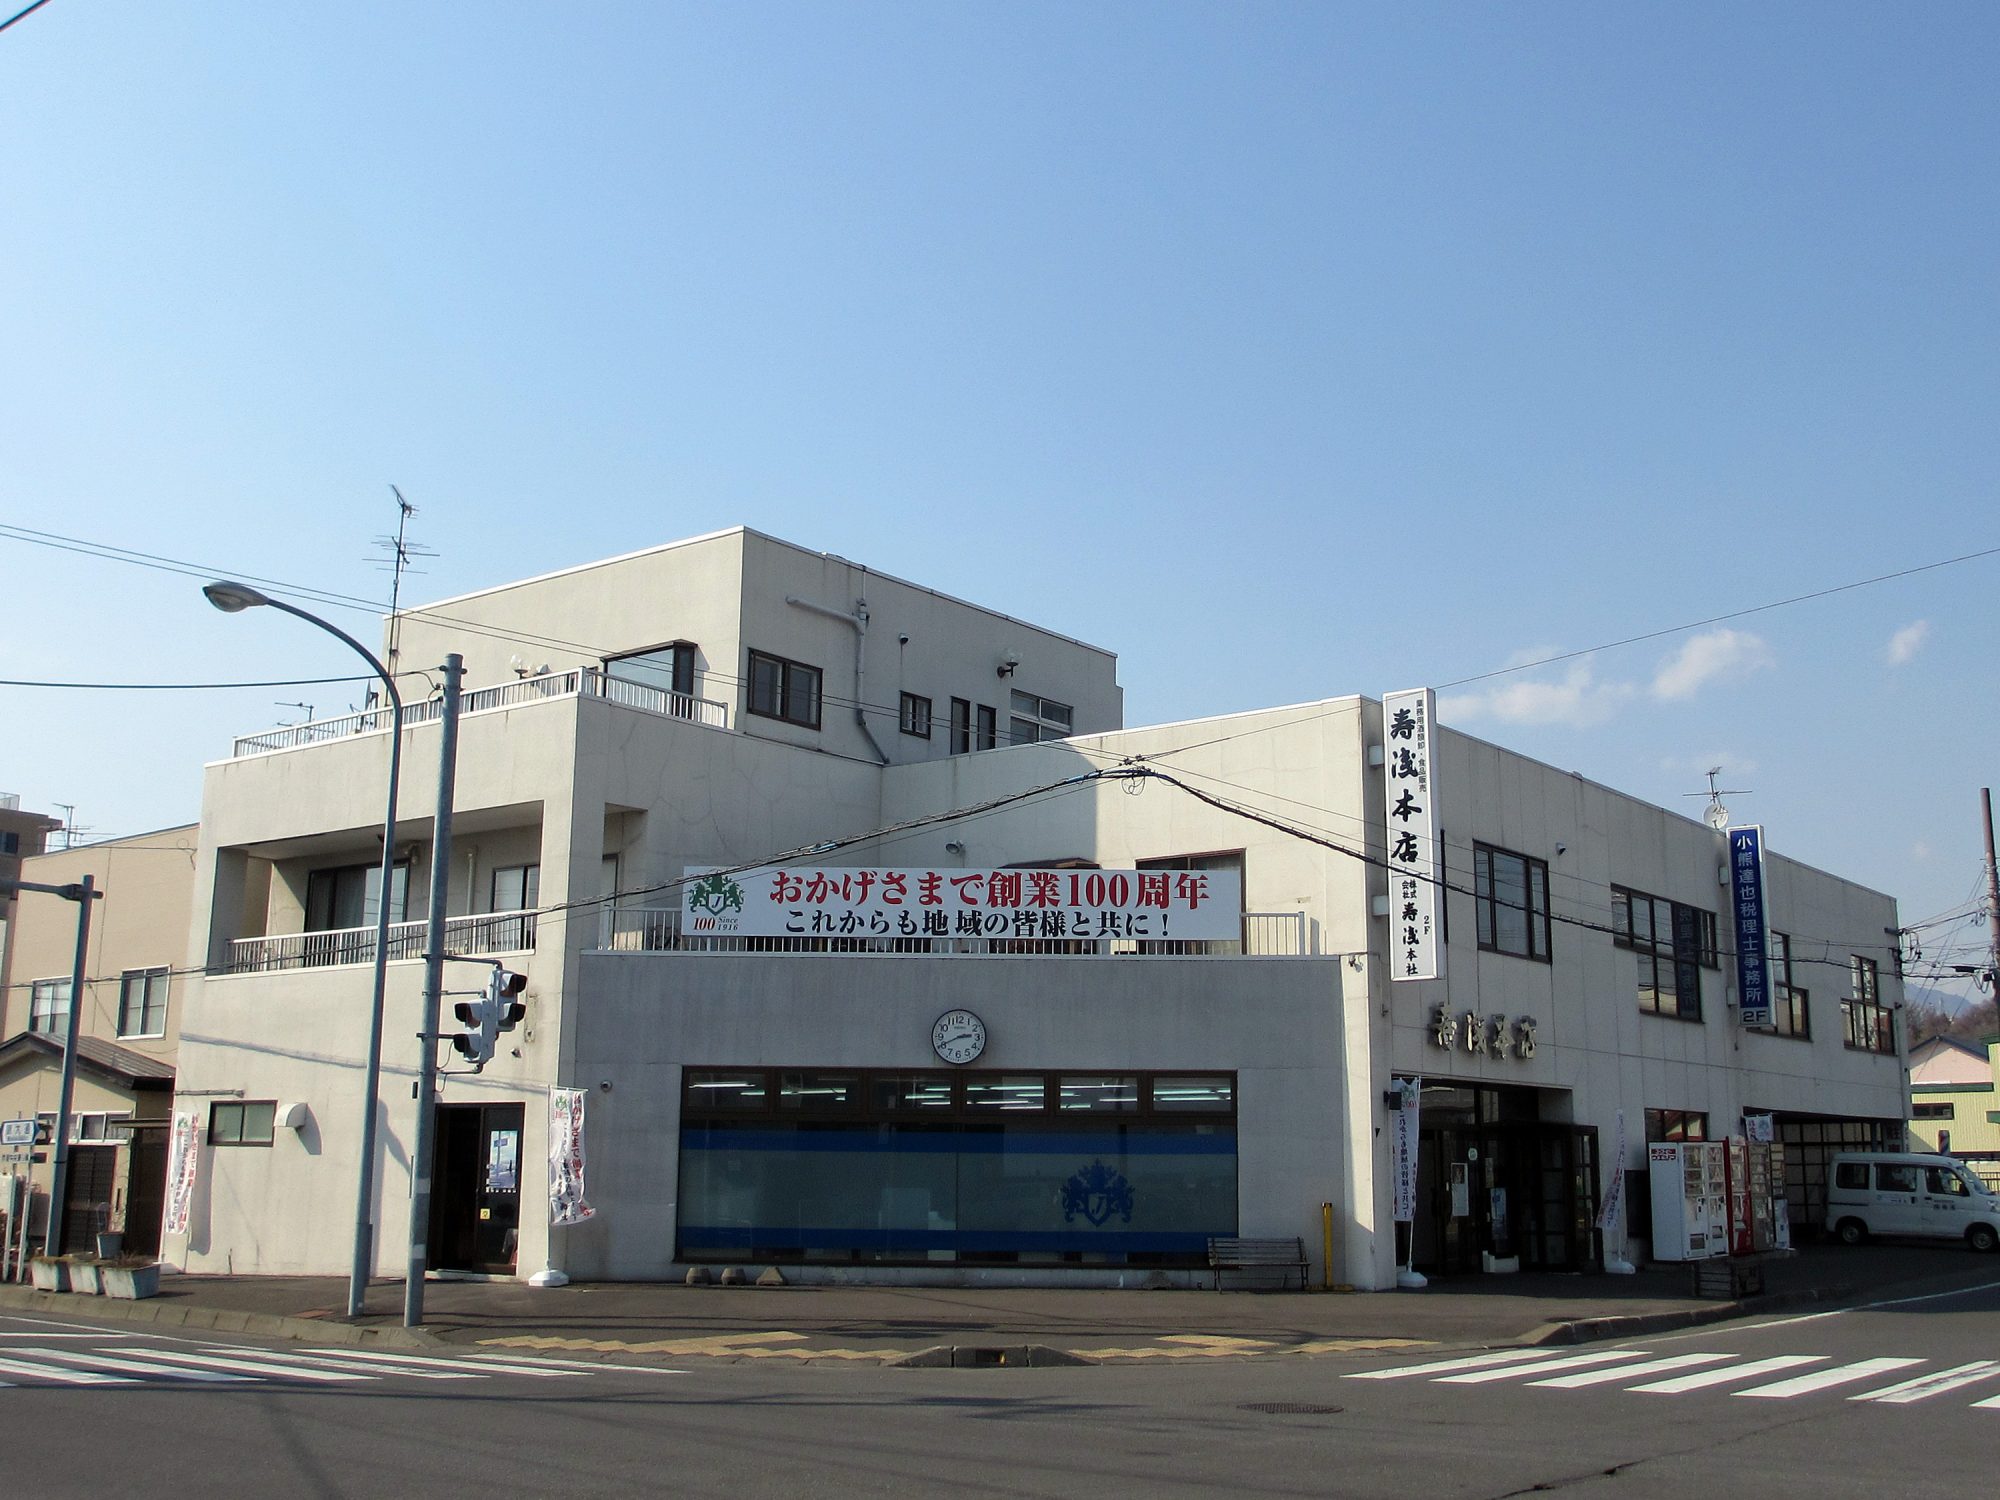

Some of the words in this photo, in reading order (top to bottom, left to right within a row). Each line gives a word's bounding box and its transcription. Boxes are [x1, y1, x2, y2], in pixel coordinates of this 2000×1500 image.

[769, 870, 1210, 910] おかげさまで創業100周年
[717, 916, 739, 924] Since
[1736, 835, 1762, 1003] 小熊達也税理士事務所
[693, 917, 716, 930] 100
[956, 1015, 965, 1024] 12
[1742, 1010, 1767, 1023] 2F
[967, 1017, 970, 1025] 1
[939, 1023, 949, 1032] 10
[972, 1024, 978, 1032] 2
[975, 1033, 981, 1041] 3
[971, 1042, 978, 1050] 4
[955, 1050, 961, 1058] 6
[964, 1048, 971, 1056] 5
